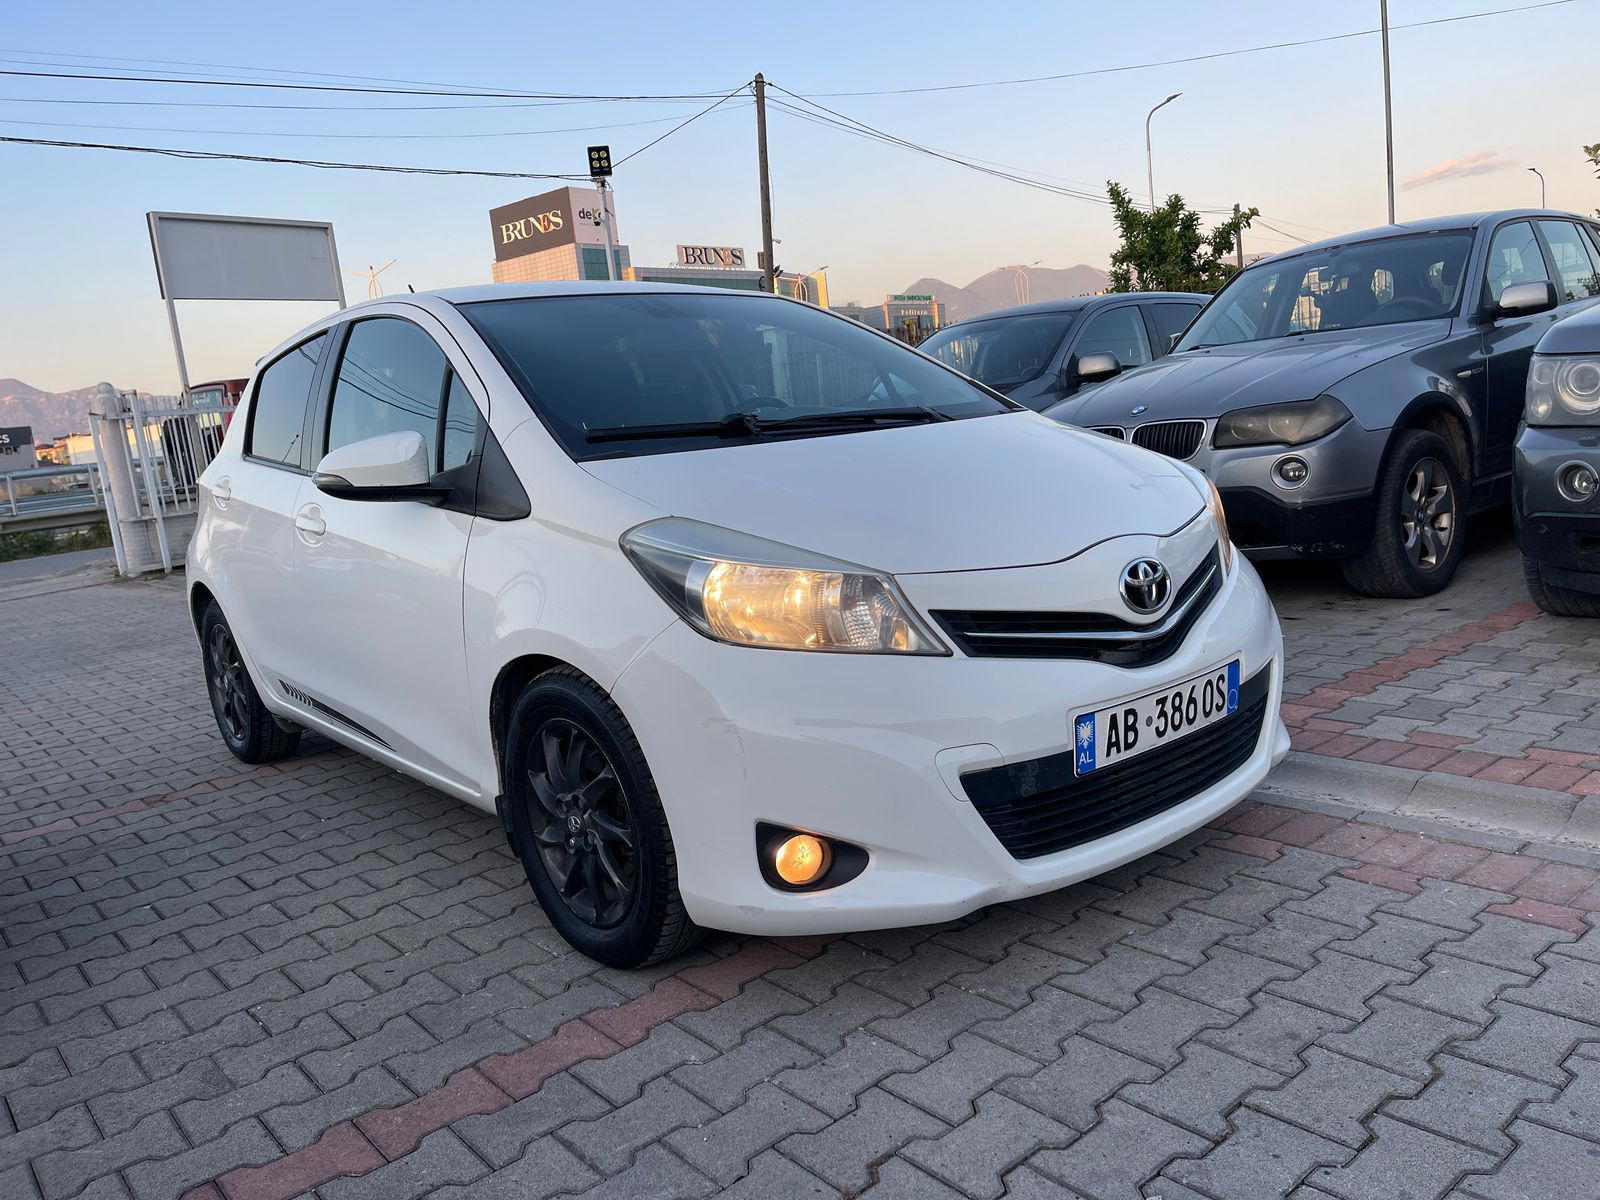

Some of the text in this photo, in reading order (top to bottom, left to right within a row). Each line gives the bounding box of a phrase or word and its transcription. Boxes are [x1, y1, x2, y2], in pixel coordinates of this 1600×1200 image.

[500, 209, 563, 245] BRUNES
[1105, 707, 1139, 758] AB
[1078, 750, 1094, 766] AL
